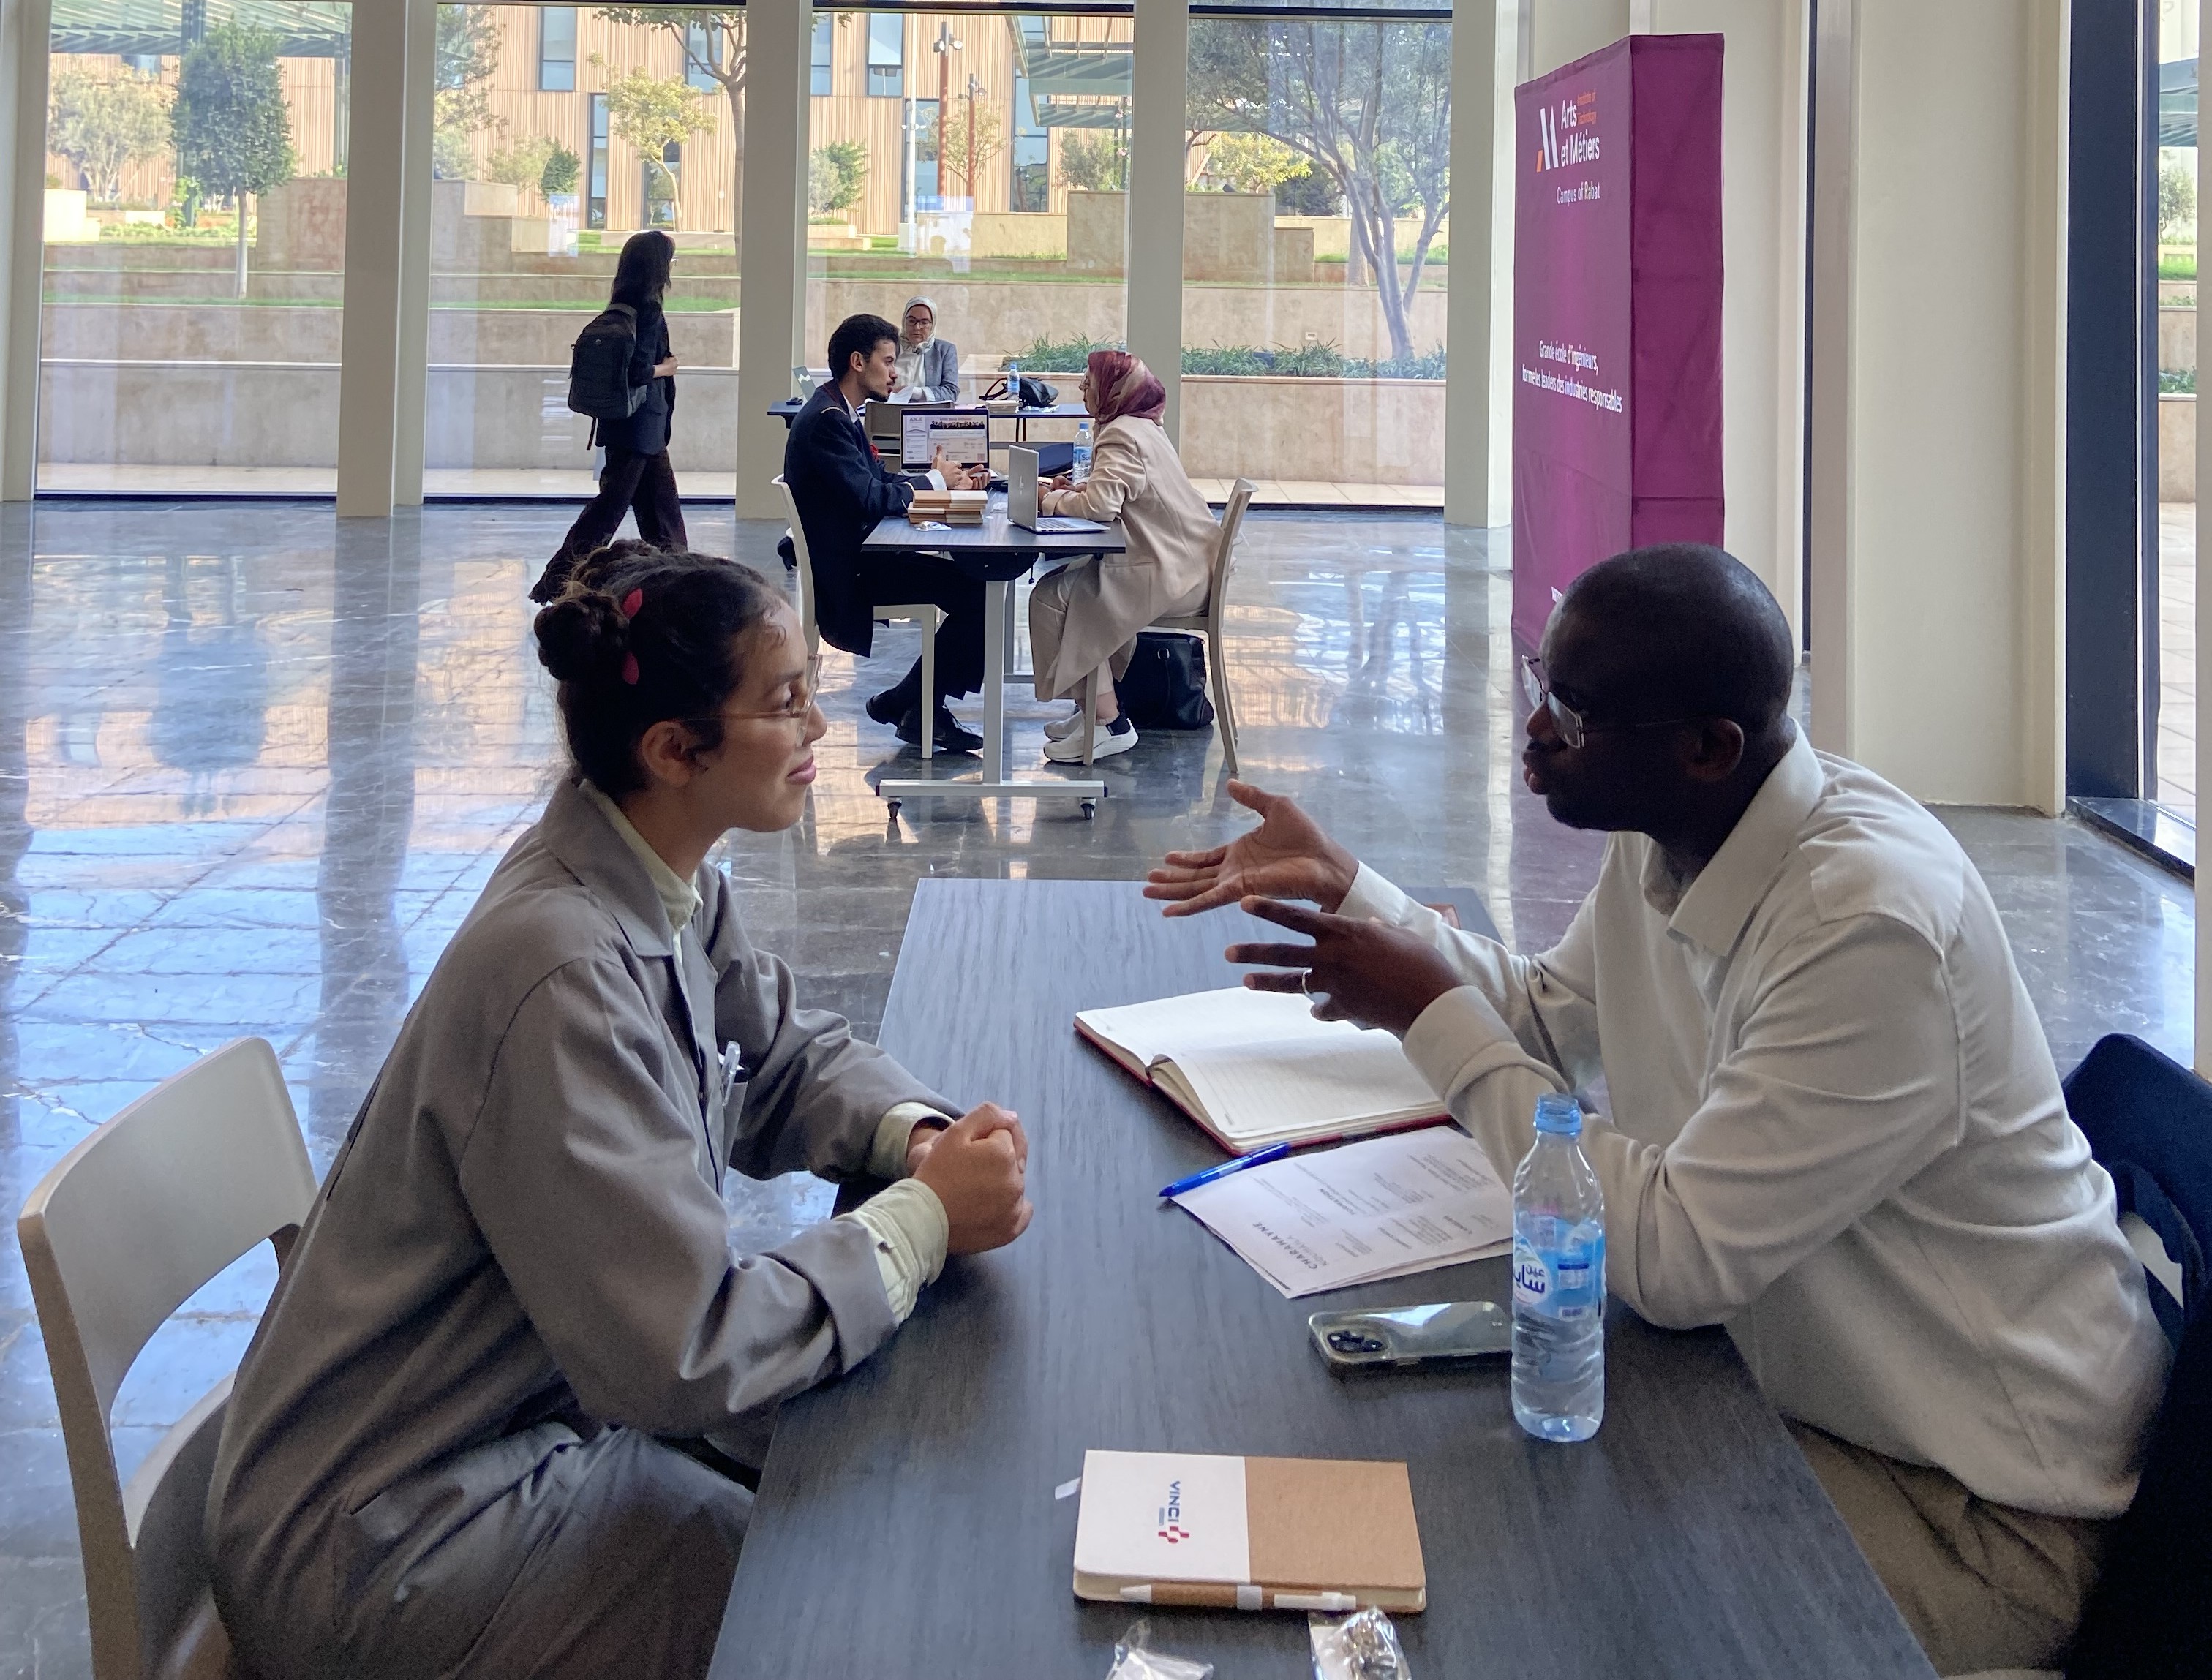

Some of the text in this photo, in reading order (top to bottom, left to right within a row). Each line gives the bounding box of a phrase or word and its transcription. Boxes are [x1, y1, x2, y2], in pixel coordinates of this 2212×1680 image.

[1560, 99, 1578, 130] Arts
[1560, 129, 1600, 167] et Métiers
[1557, 180, 1600, 207] Campus of Rabat
[1539, 340, 1555, 361] Grande
[1588, 387, 1622, 413] responsables
[1525, 1264, 1545, 1278] عين
[1167, 1480, 1181, 1523] VINCI
